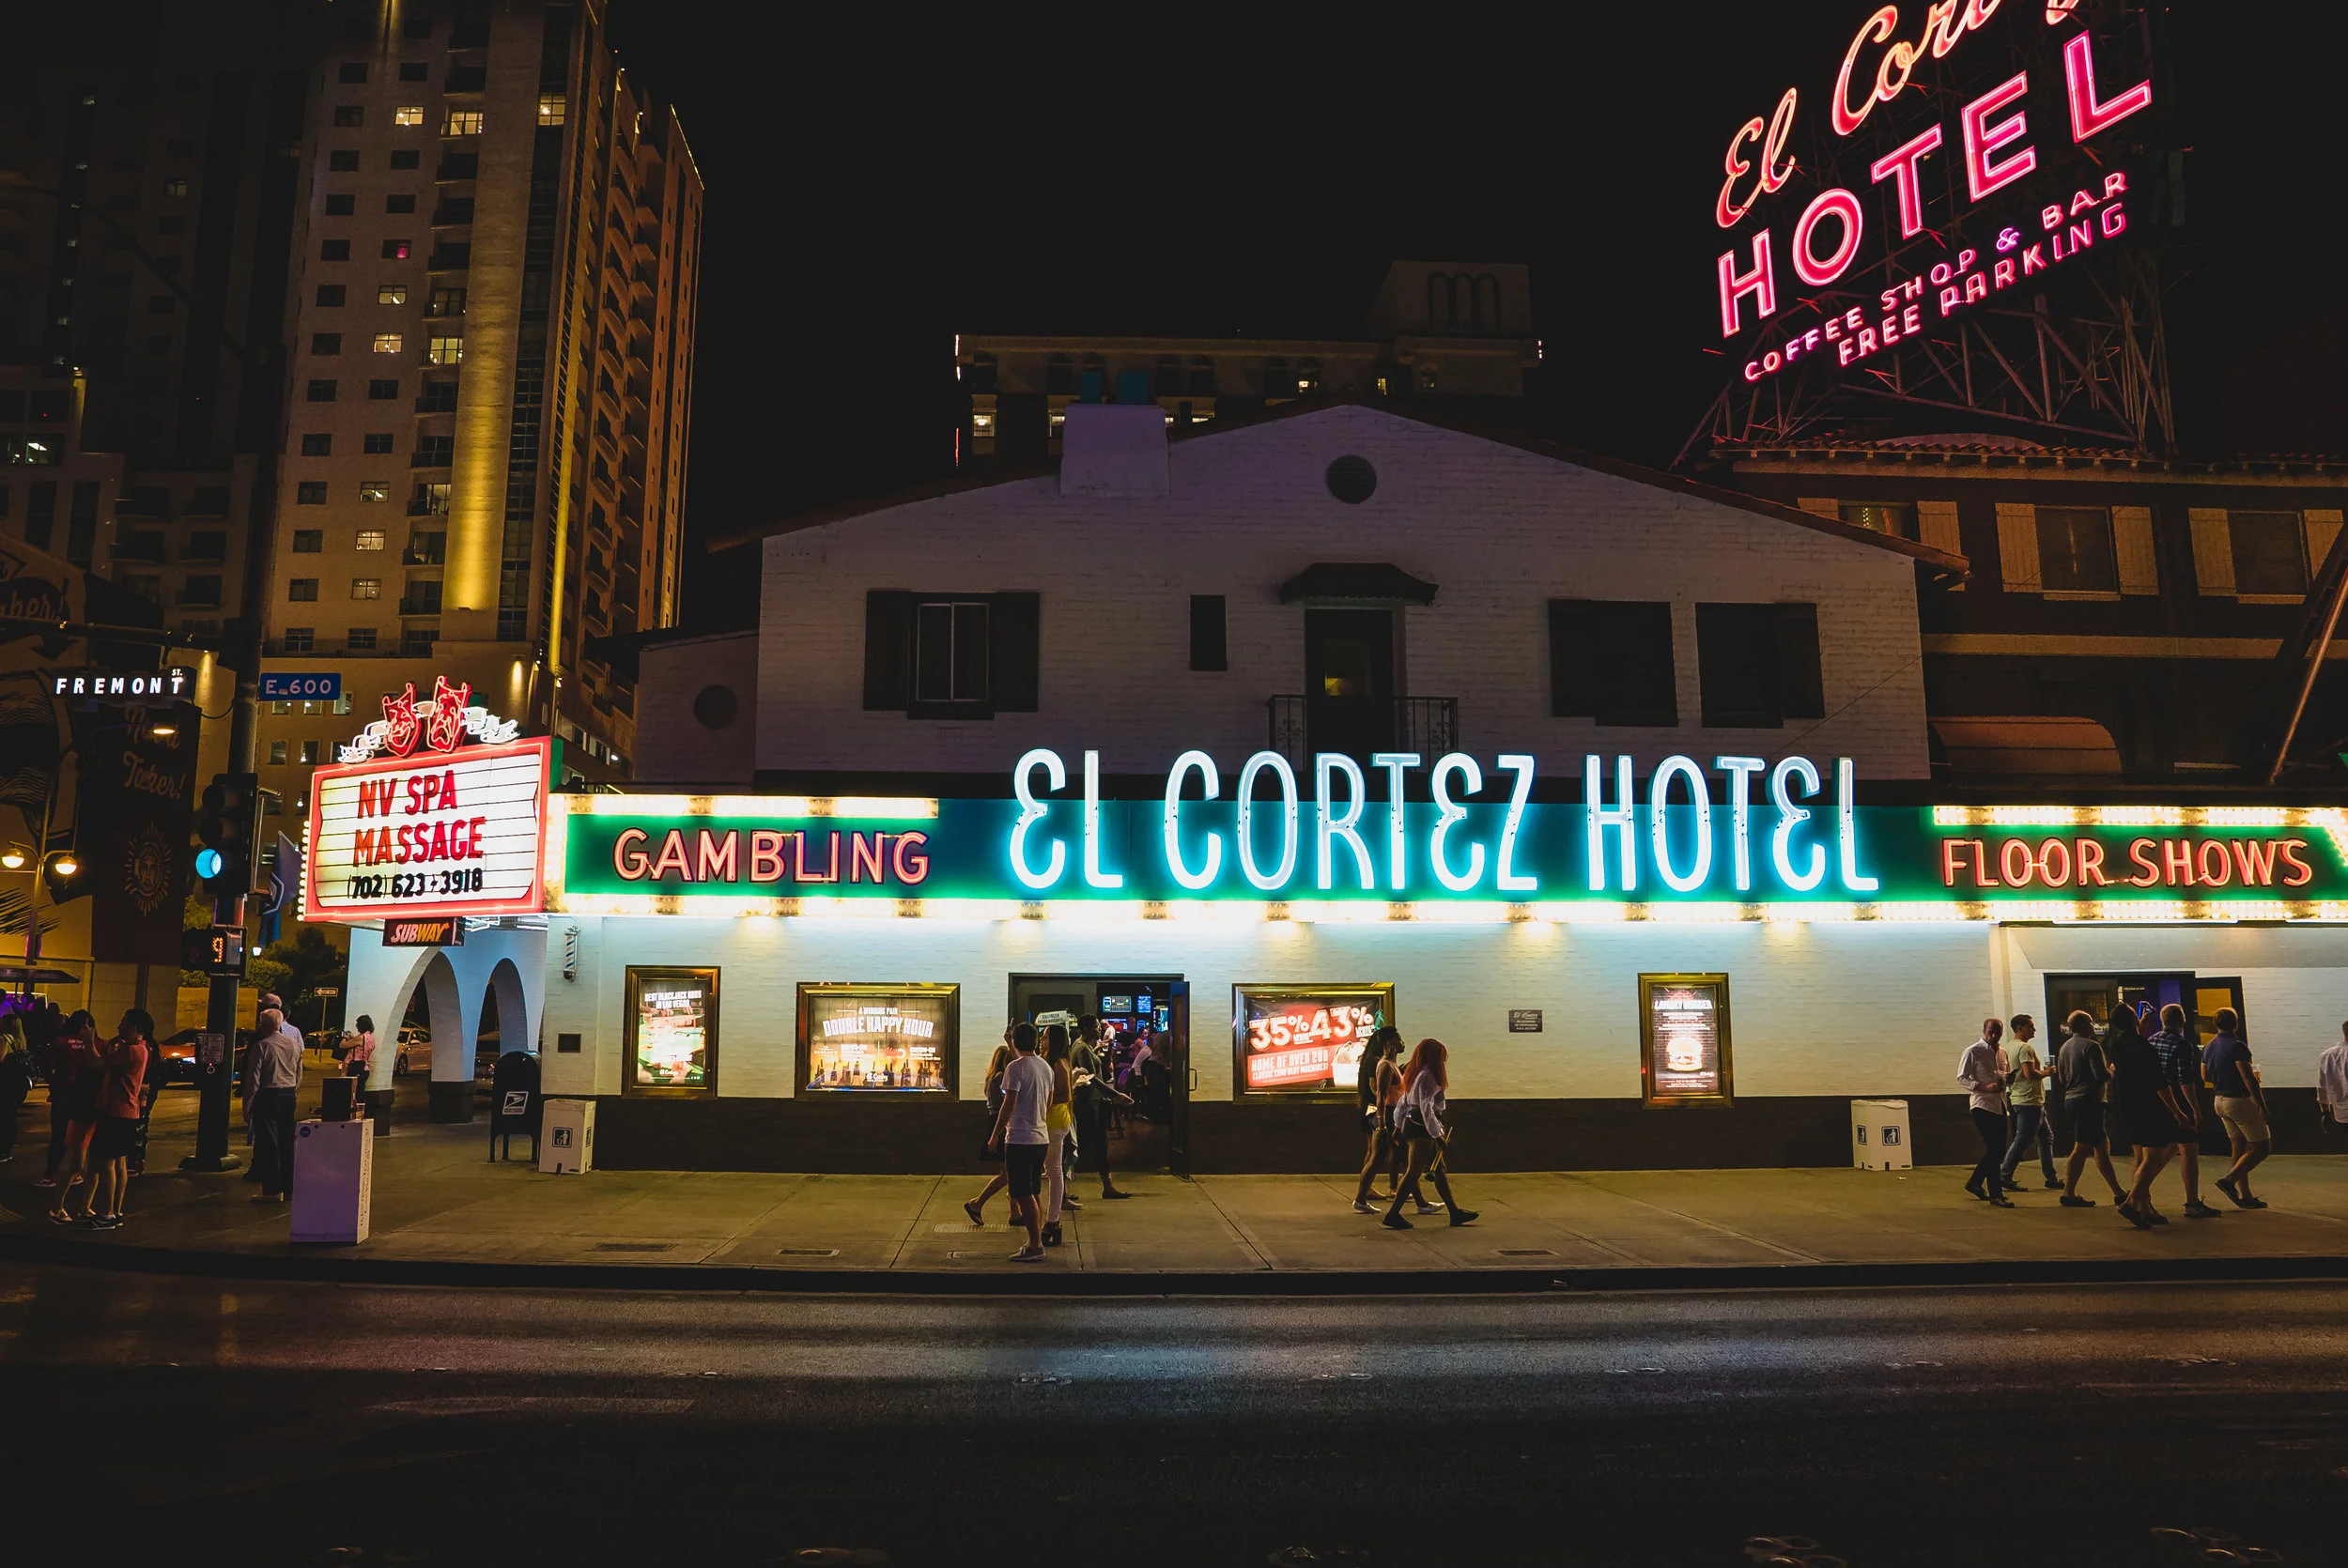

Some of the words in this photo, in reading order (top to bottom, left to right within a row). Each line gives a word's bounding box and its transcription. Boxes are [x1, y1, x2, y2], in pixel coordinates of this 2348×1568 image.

[1716, 87, 1797, 227] El
[1831, 0, 2078, 135] Cor
[1718, 30, 2152, 338] HOTEL
[1745, 306, 1864, 381] COFFEE
[1881, 248, 1977, 311] SHOP
[1995, 227, 2021, 252] &
[2042, 172, 2127, 229] BAR
[1838, 304, 1922, 366] FREE
[1939, 203, 2127, 316] PARKING
[56, 677, 184, 695] FREMONT
[289, 679, 332, 695] 600
[357, 776, 398, 820] NV
[404, 769, 458, 816] SPA
[352, 816, 487, 868] MASSAGE
[1010, 748, 1124, 891] EL
[1163, 749, 1538, 892] CORTEZ
[1585, 753, 1880, 892] HOTEL
[612, 827, 931, 885] GAMBLING
[1941, 837, 2106, 888] FLOOR
[2129, 838, 2313, 887] SHOWS
[348, 874, 387, 899] (702)
[212, 936, 224, 963] 9
[391, 922, 450, 943] SUBWAY
[823, 1016, 866, 1038] DOUBLE
[866, 1016, 904, 1034] HAPPY
[903, 1018, 934, 1038] HOUR
[1249, 1015, 1310, 1052] 35%
[1309, 1006, 1375, 1039] 43%
[1251, 1056, 1274, 1072] HOME
[1276, 1054, 1287, 1068] OF
[1289, 1052, 1310, 1067] OVER
[1311, 1049, 1329, 1063] 200
[1252, 1068, 1274, 1081] CLASSIC
[1287, 1066, 1301, 1076] SLOT
